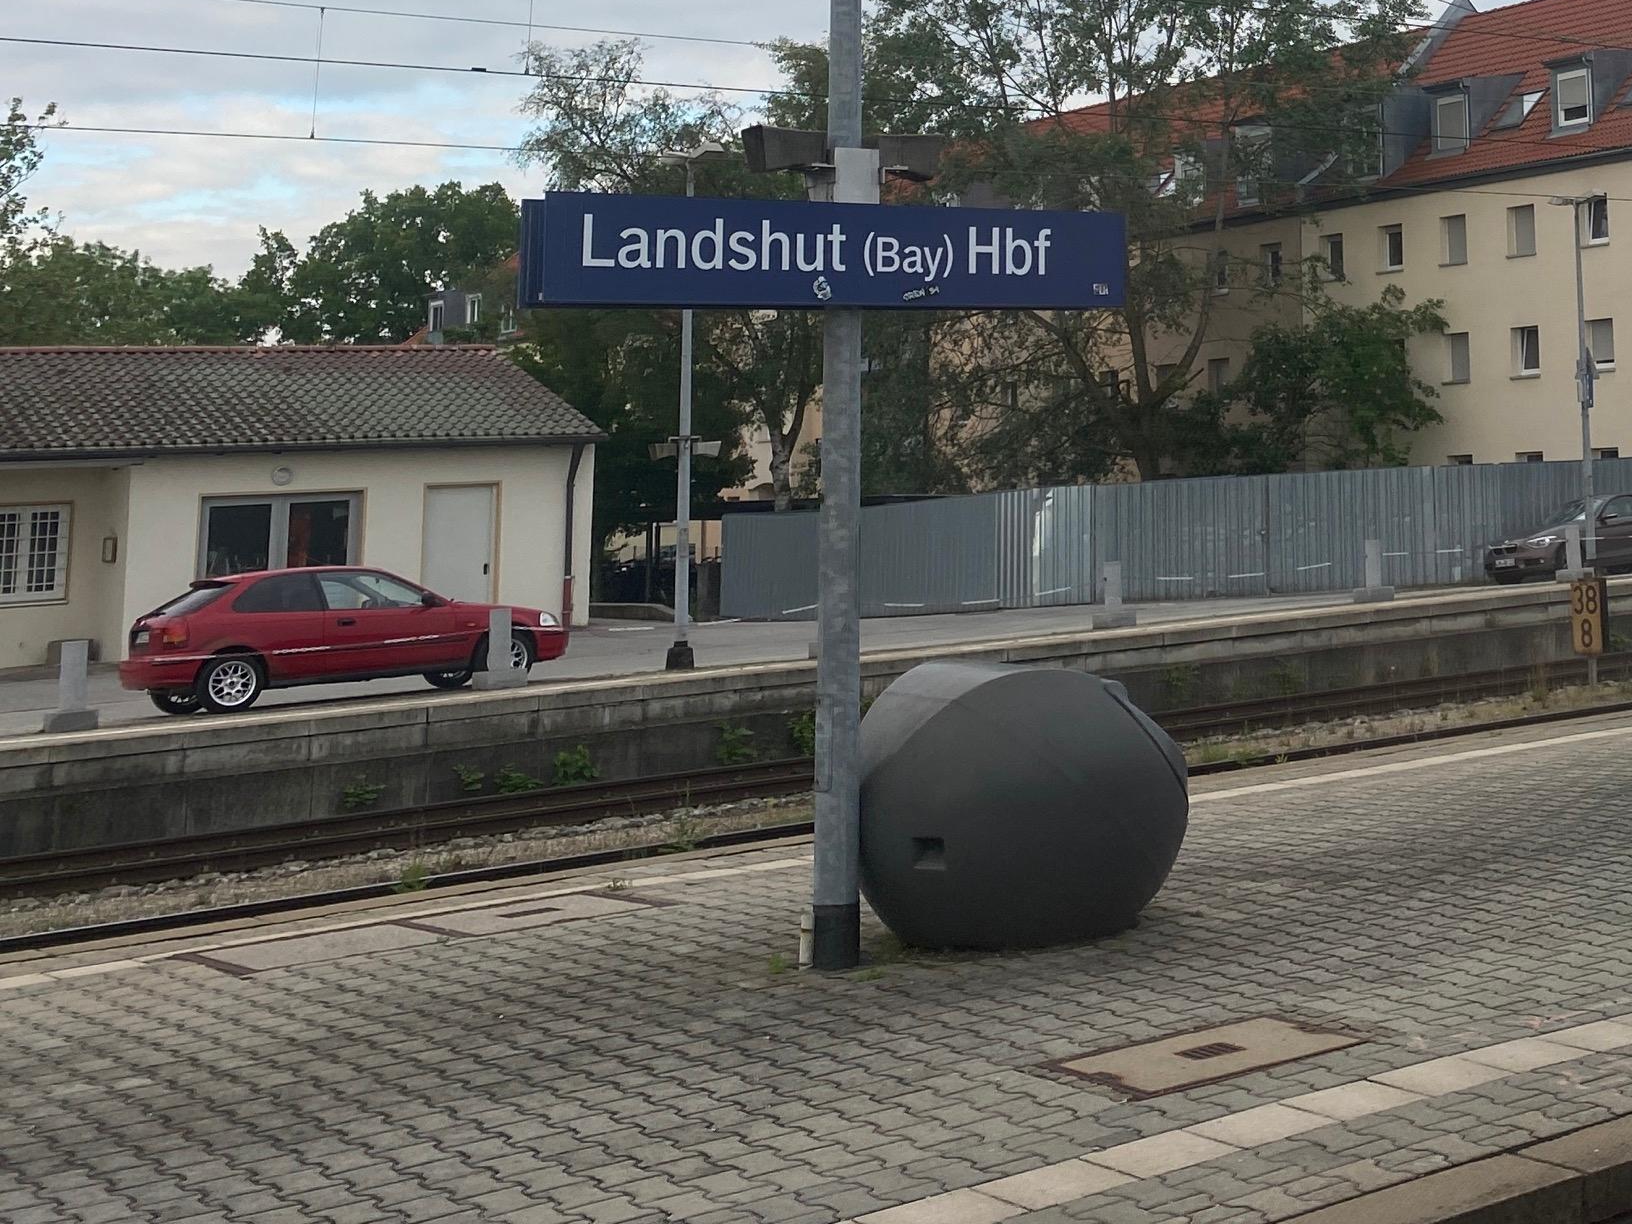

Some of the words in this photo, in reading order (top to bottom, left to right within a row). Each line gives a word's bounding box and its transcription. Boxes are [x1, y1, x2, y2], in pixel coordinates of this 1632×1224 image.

[582, 213, 847, 272] Landshut
[863, 232, 954, 282] (Bay)
[968, 226, 1052, 276] Hbf
[1573, 585, 1598, 615] 38
[1581, 618, 1593, 648] 8
